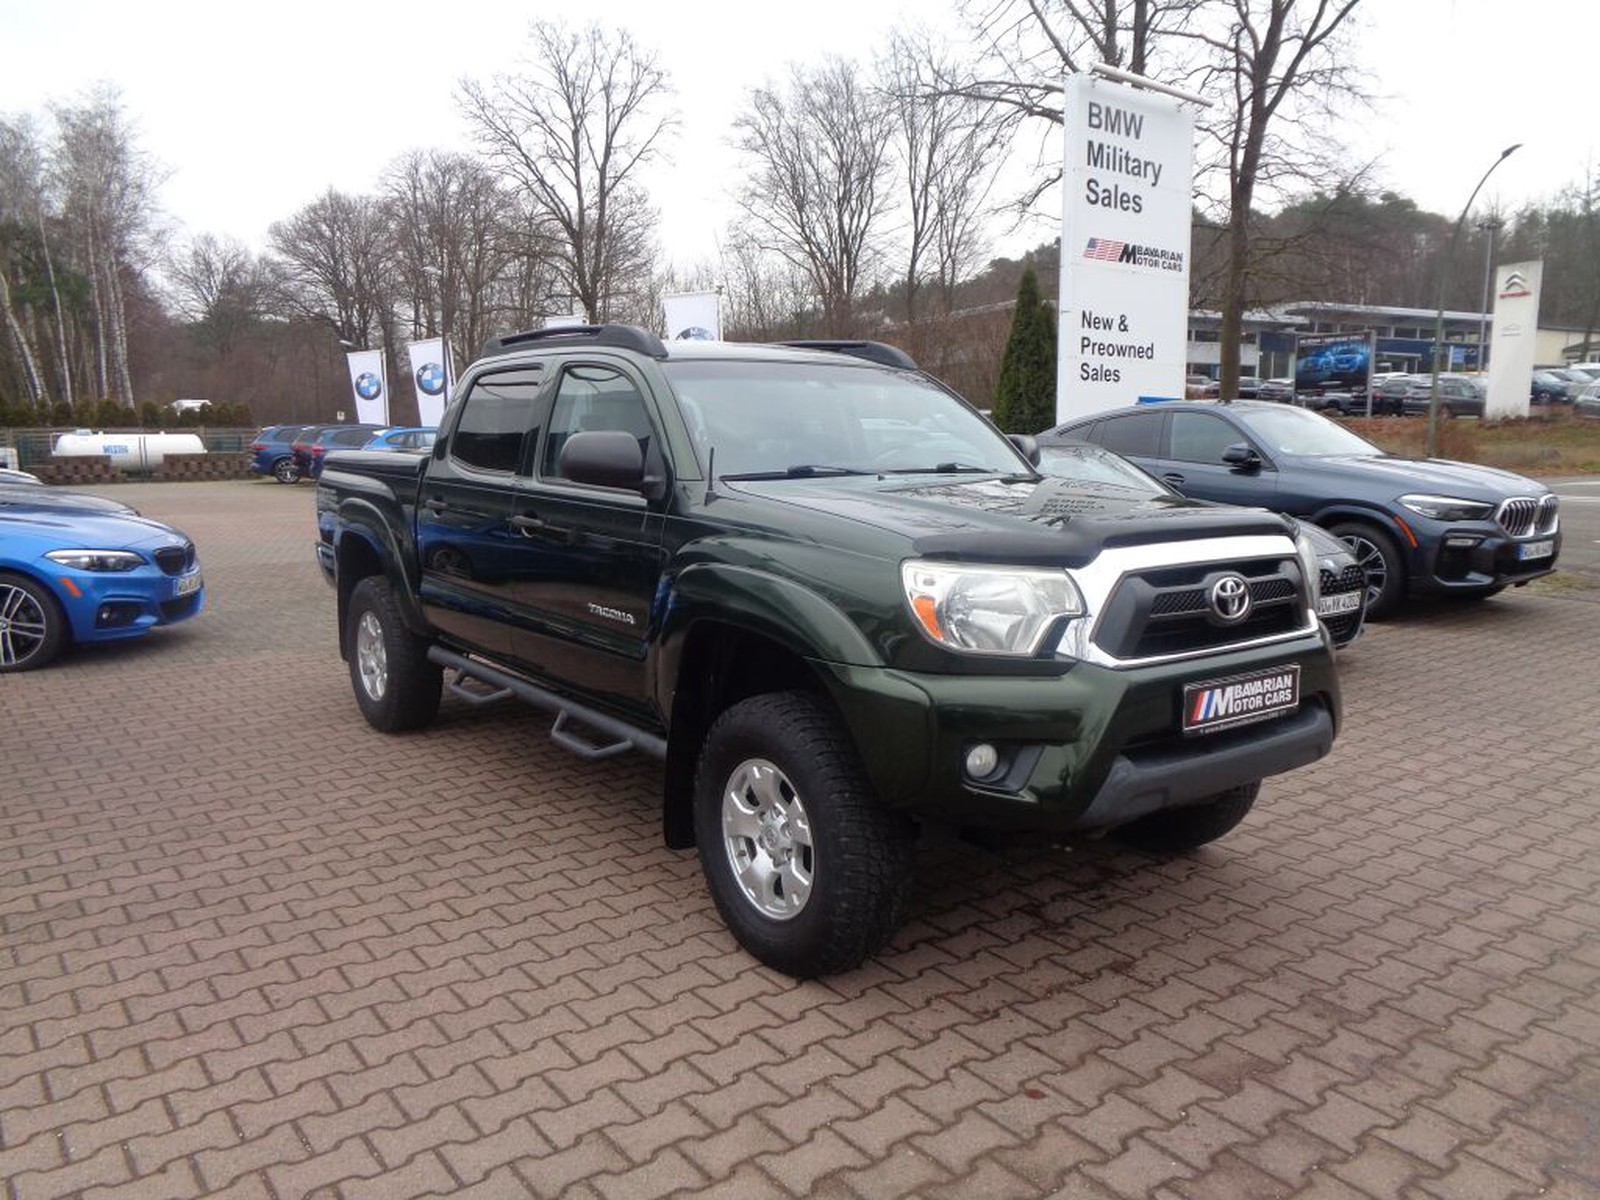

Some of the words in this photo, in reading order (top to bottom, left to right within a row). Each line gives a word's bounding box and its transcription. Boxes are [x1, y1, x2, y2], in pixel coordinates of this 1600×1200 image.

[1088, 101, 1144, 140] BMW
[1087, 139, 1162, 187] Military
[1086, 178, 1143, 213] Sales
[1137, 245, 1184, 262] BAVARIAN
[1161, 260, 1183, 272] CARS
[1081, 310, 1114, 331] New
[1118, 314, 1129, 332] &
[1080, 336, 1154, 360] Preowned
[1080, 362, 1121, 382] Sales
[1233, 674, 1293, 699] BAVARIAN
[1264, 688, 1293, 705] CARS
